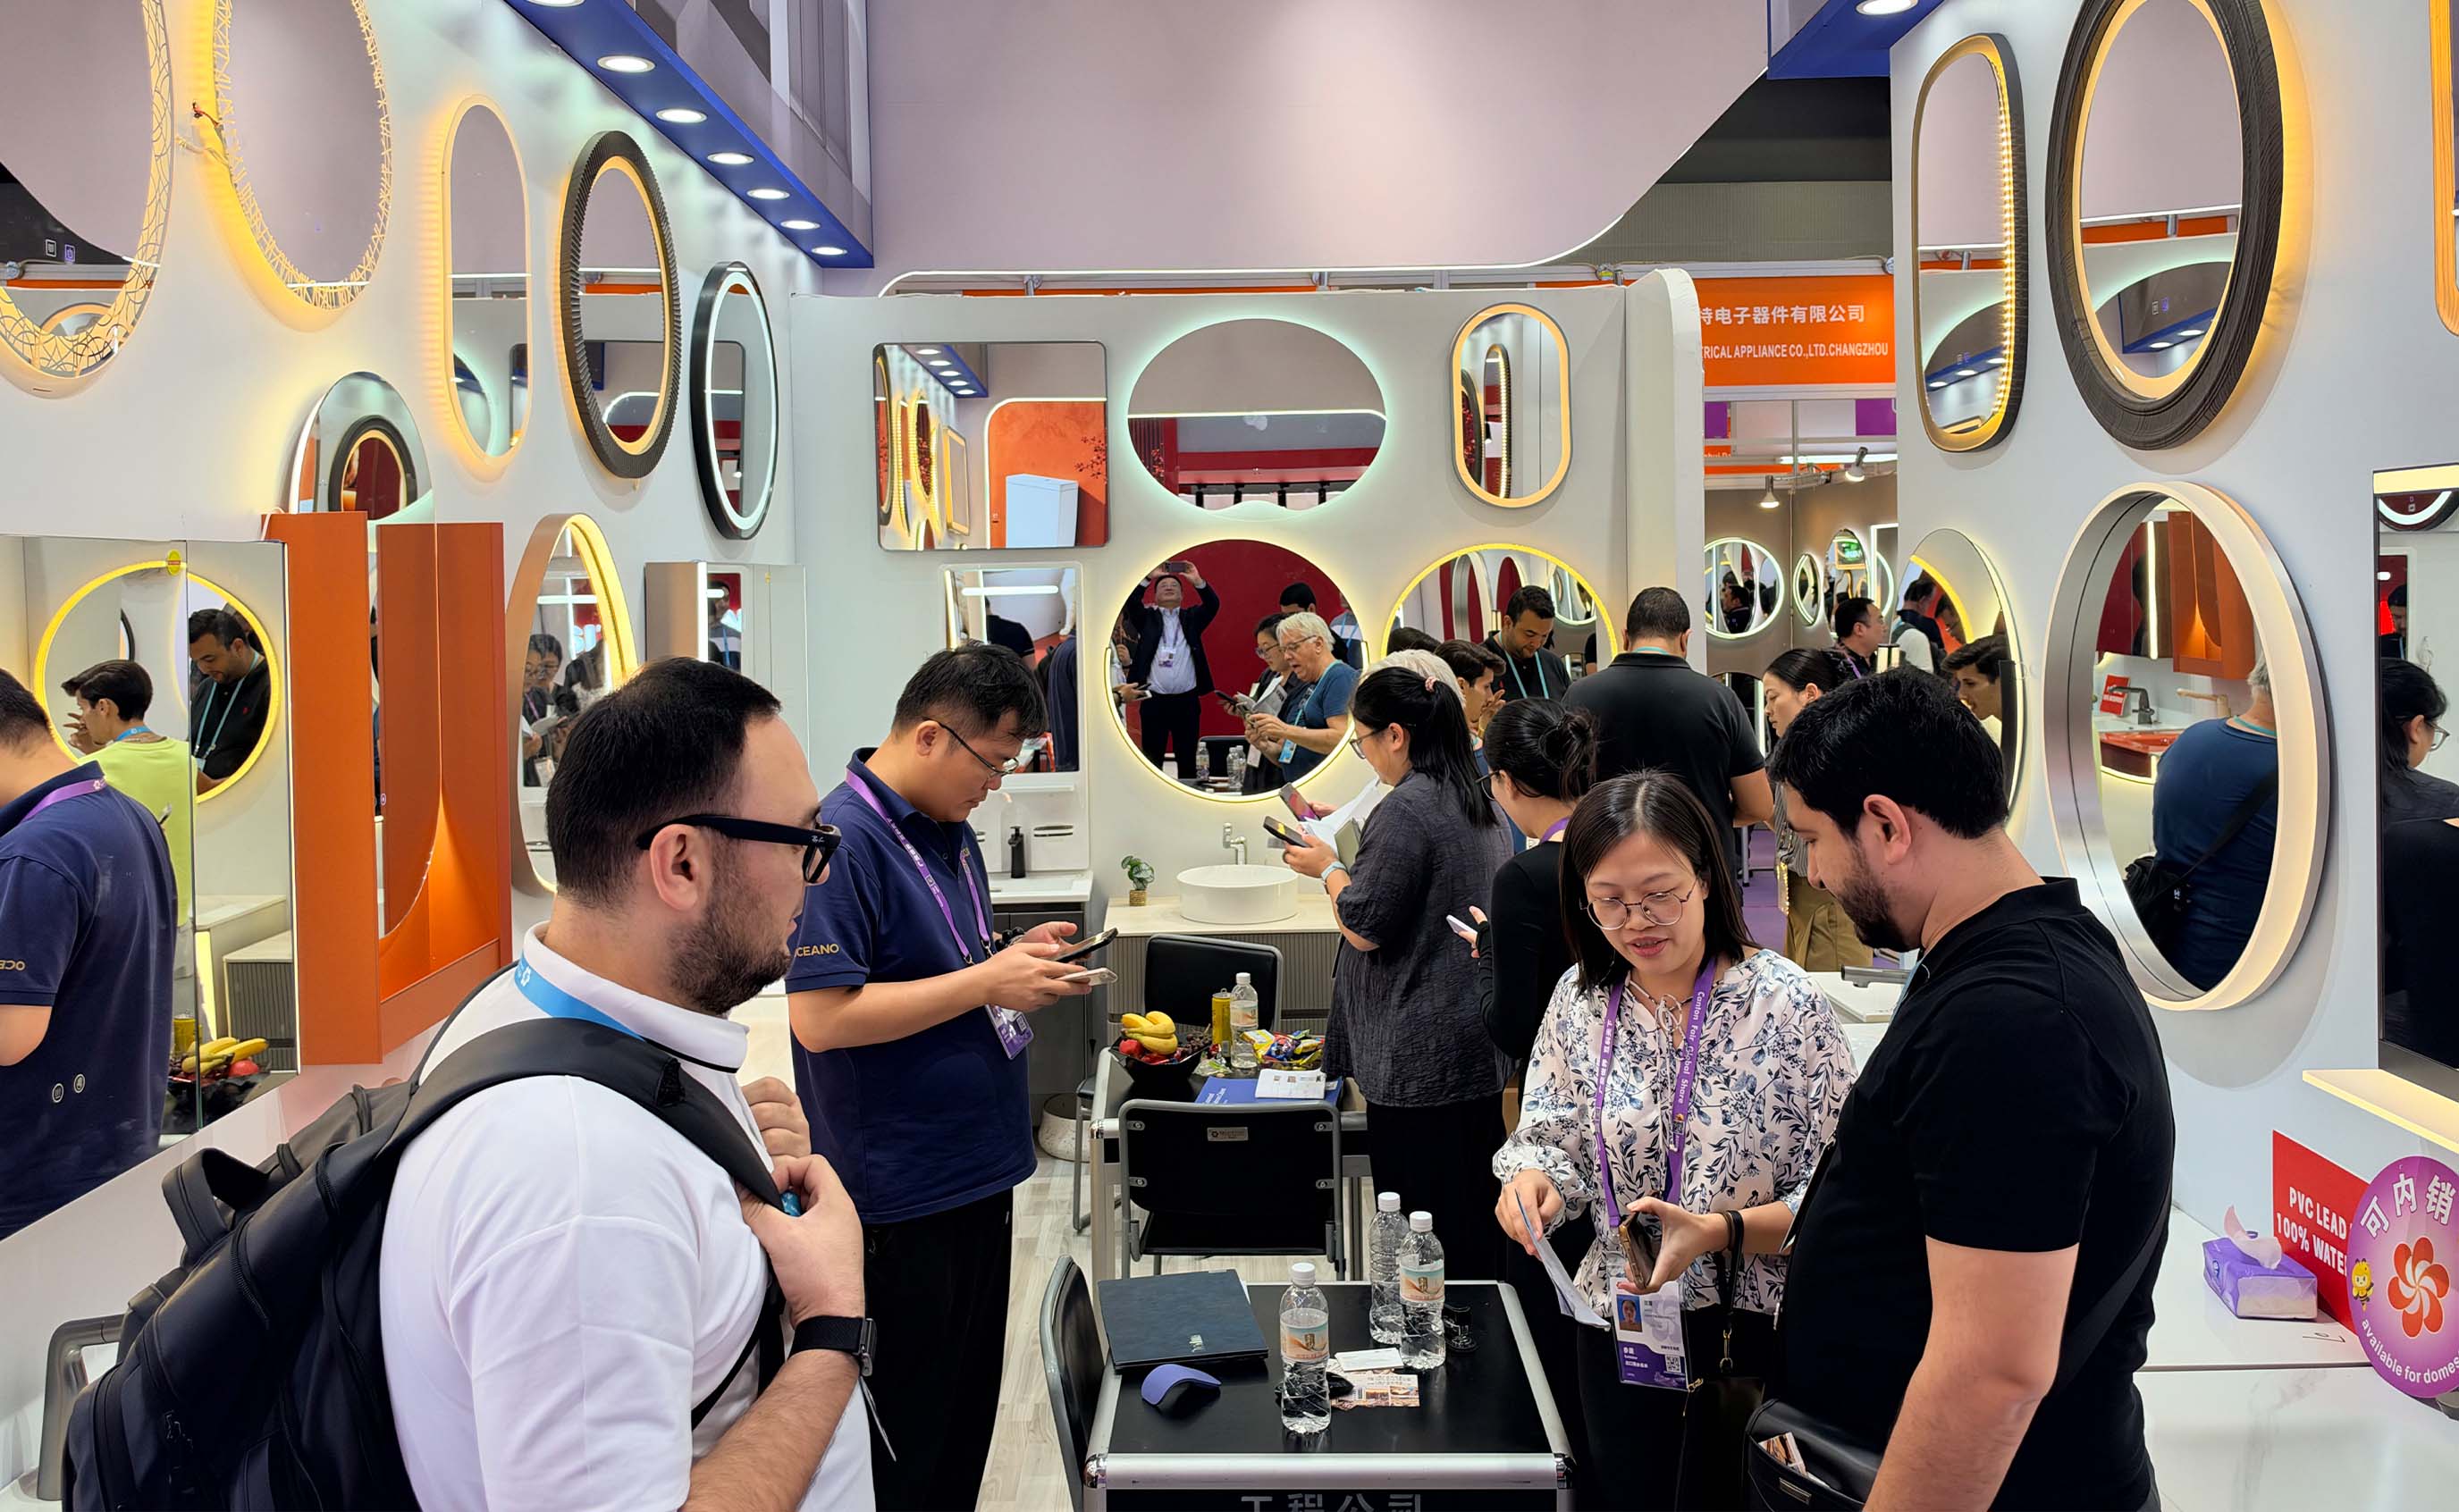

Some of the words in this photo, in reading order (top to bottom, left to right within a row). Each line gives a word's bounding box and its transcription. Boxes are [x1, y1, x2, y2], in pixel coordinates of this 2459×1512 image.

[1734, 344, 1788, 358] APPLIANCE
[795, 944, 839, 957] CEANO
[1693, 991, 1705, 1021] Canton
[1688, 1024, 1698, 1042] Fair
[1678, 1079, 1688, 1105] Share
[2289, 1186, 2314, 1220] PVC
[2316, 1202, 2347, 1240] LEAD
[2360, 1172, 2456, 1239] 可内销
[2277, 1212, 2310, 1253] 100%
[2362, 1319, 2403, 1376] available
[2404, 1365, 2421, 1383] for
[2423, 1354, 2459, 1383] domes
